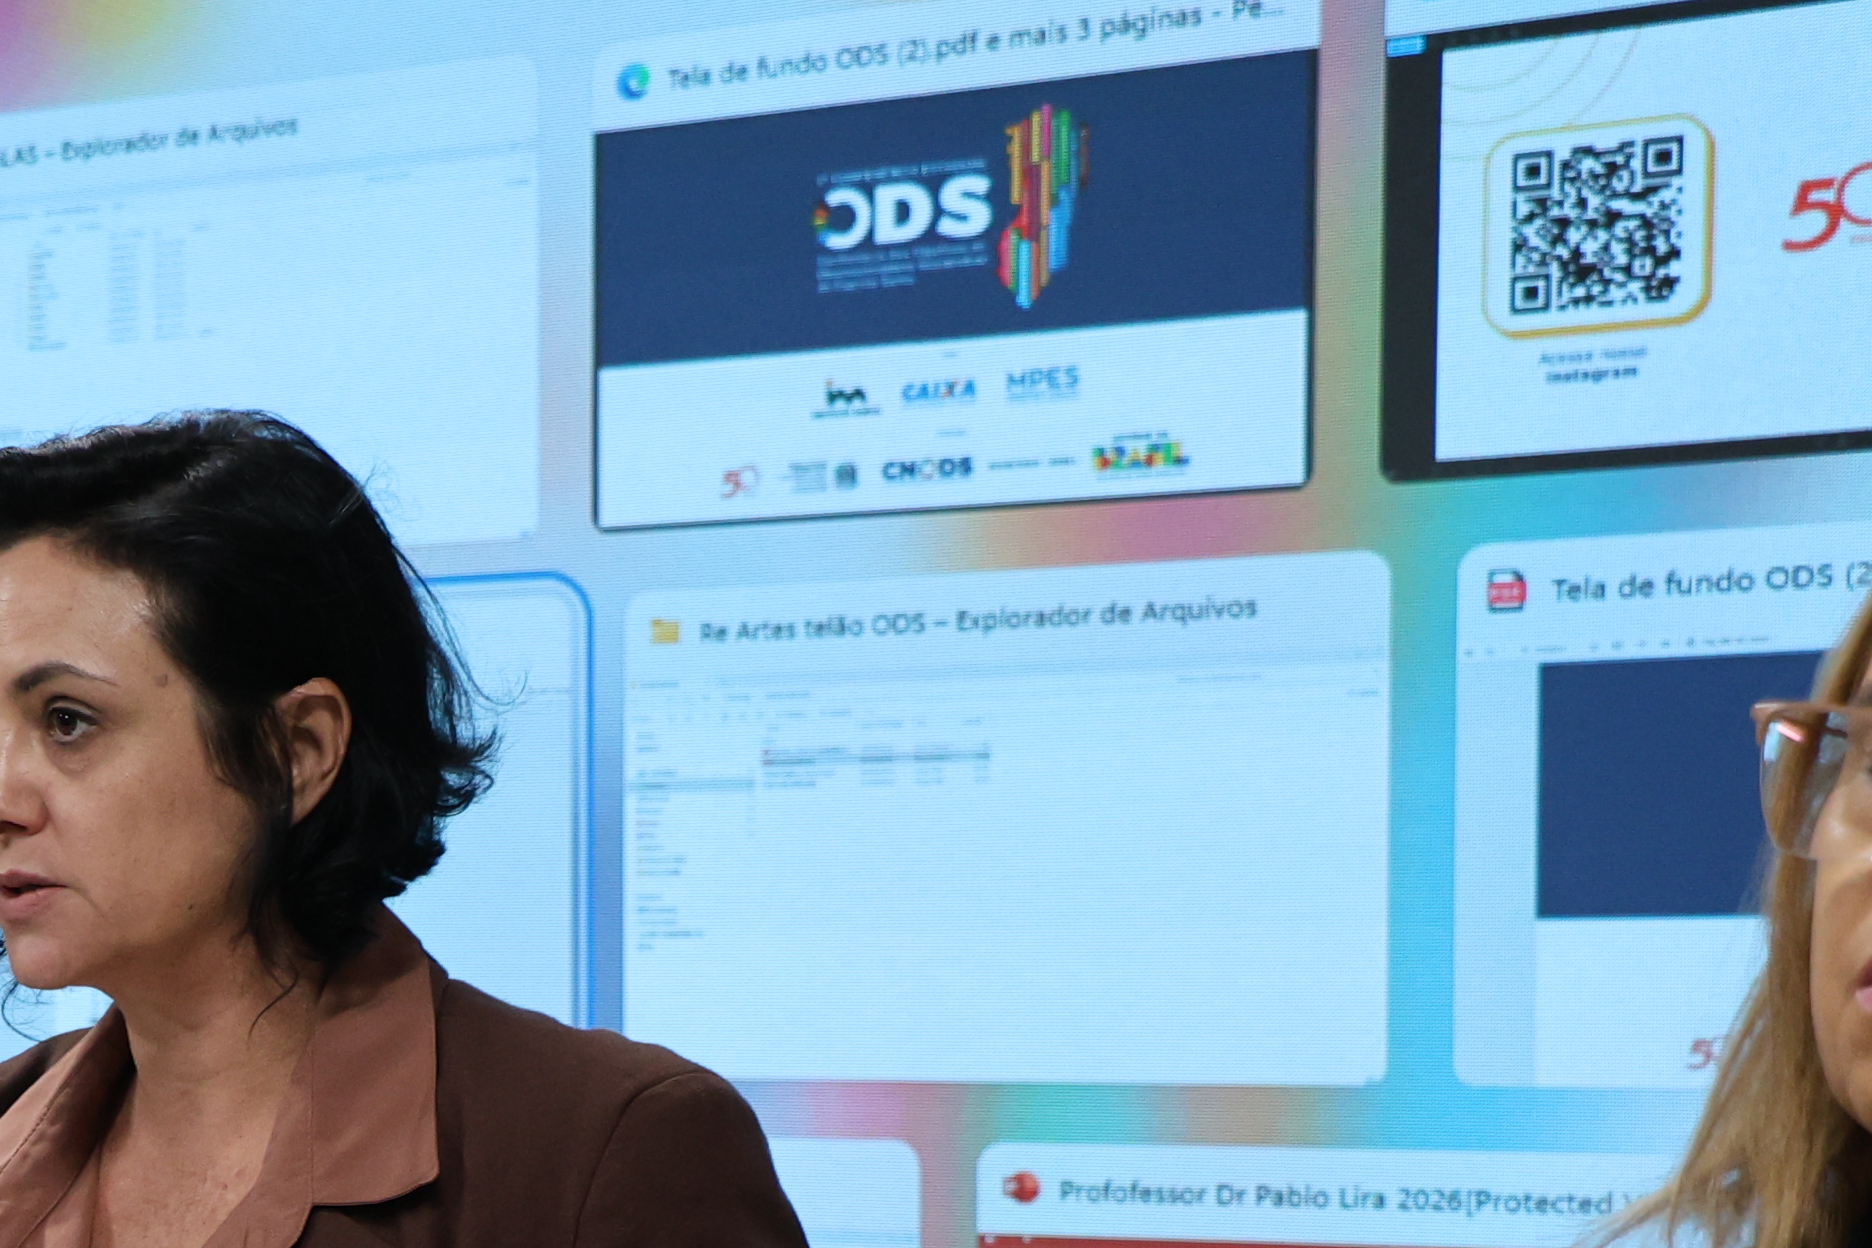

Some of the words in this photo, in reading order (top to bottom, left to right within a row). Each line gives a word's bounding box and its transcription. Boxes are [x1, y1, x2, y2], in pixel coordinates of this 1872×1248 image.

[668, 62, 711, 89] Tela
[718, 60, 749, 84] de
[756, 48, 827, 79] fundo
[835, 41, 888, 70] ODS
[986, 33, 1000, 50] e
[1008, 19, 1068, 49] mais
[1098, 8, 1202, 44] páginas
[60, 129, 169, 162] Explorador
[174, 125, 199, 148] de
[205, 116, 299, 145] Arquivos
[812, 173, 995, 251] ODS
[900, 378, 976, 403] CAIXA
[1551, 574, 1607, 602] Tela
[1617, 571, 1656, 599] de
[1664, 567, 1756, 597] fundo
[1764, 563, 1834, 592] ODS
[735, 620, 796, 642] Artes
[871, 611, 926, 635] ODS
[955, 603, 1091, 635] Explorador
[1099, 599, 1134, 626] de
[1140, 594, 1258, 628] Arquivos
[1215, 1182, 1245, 1207] Dr
[1337, 1184, 1385, 1211] Lira
